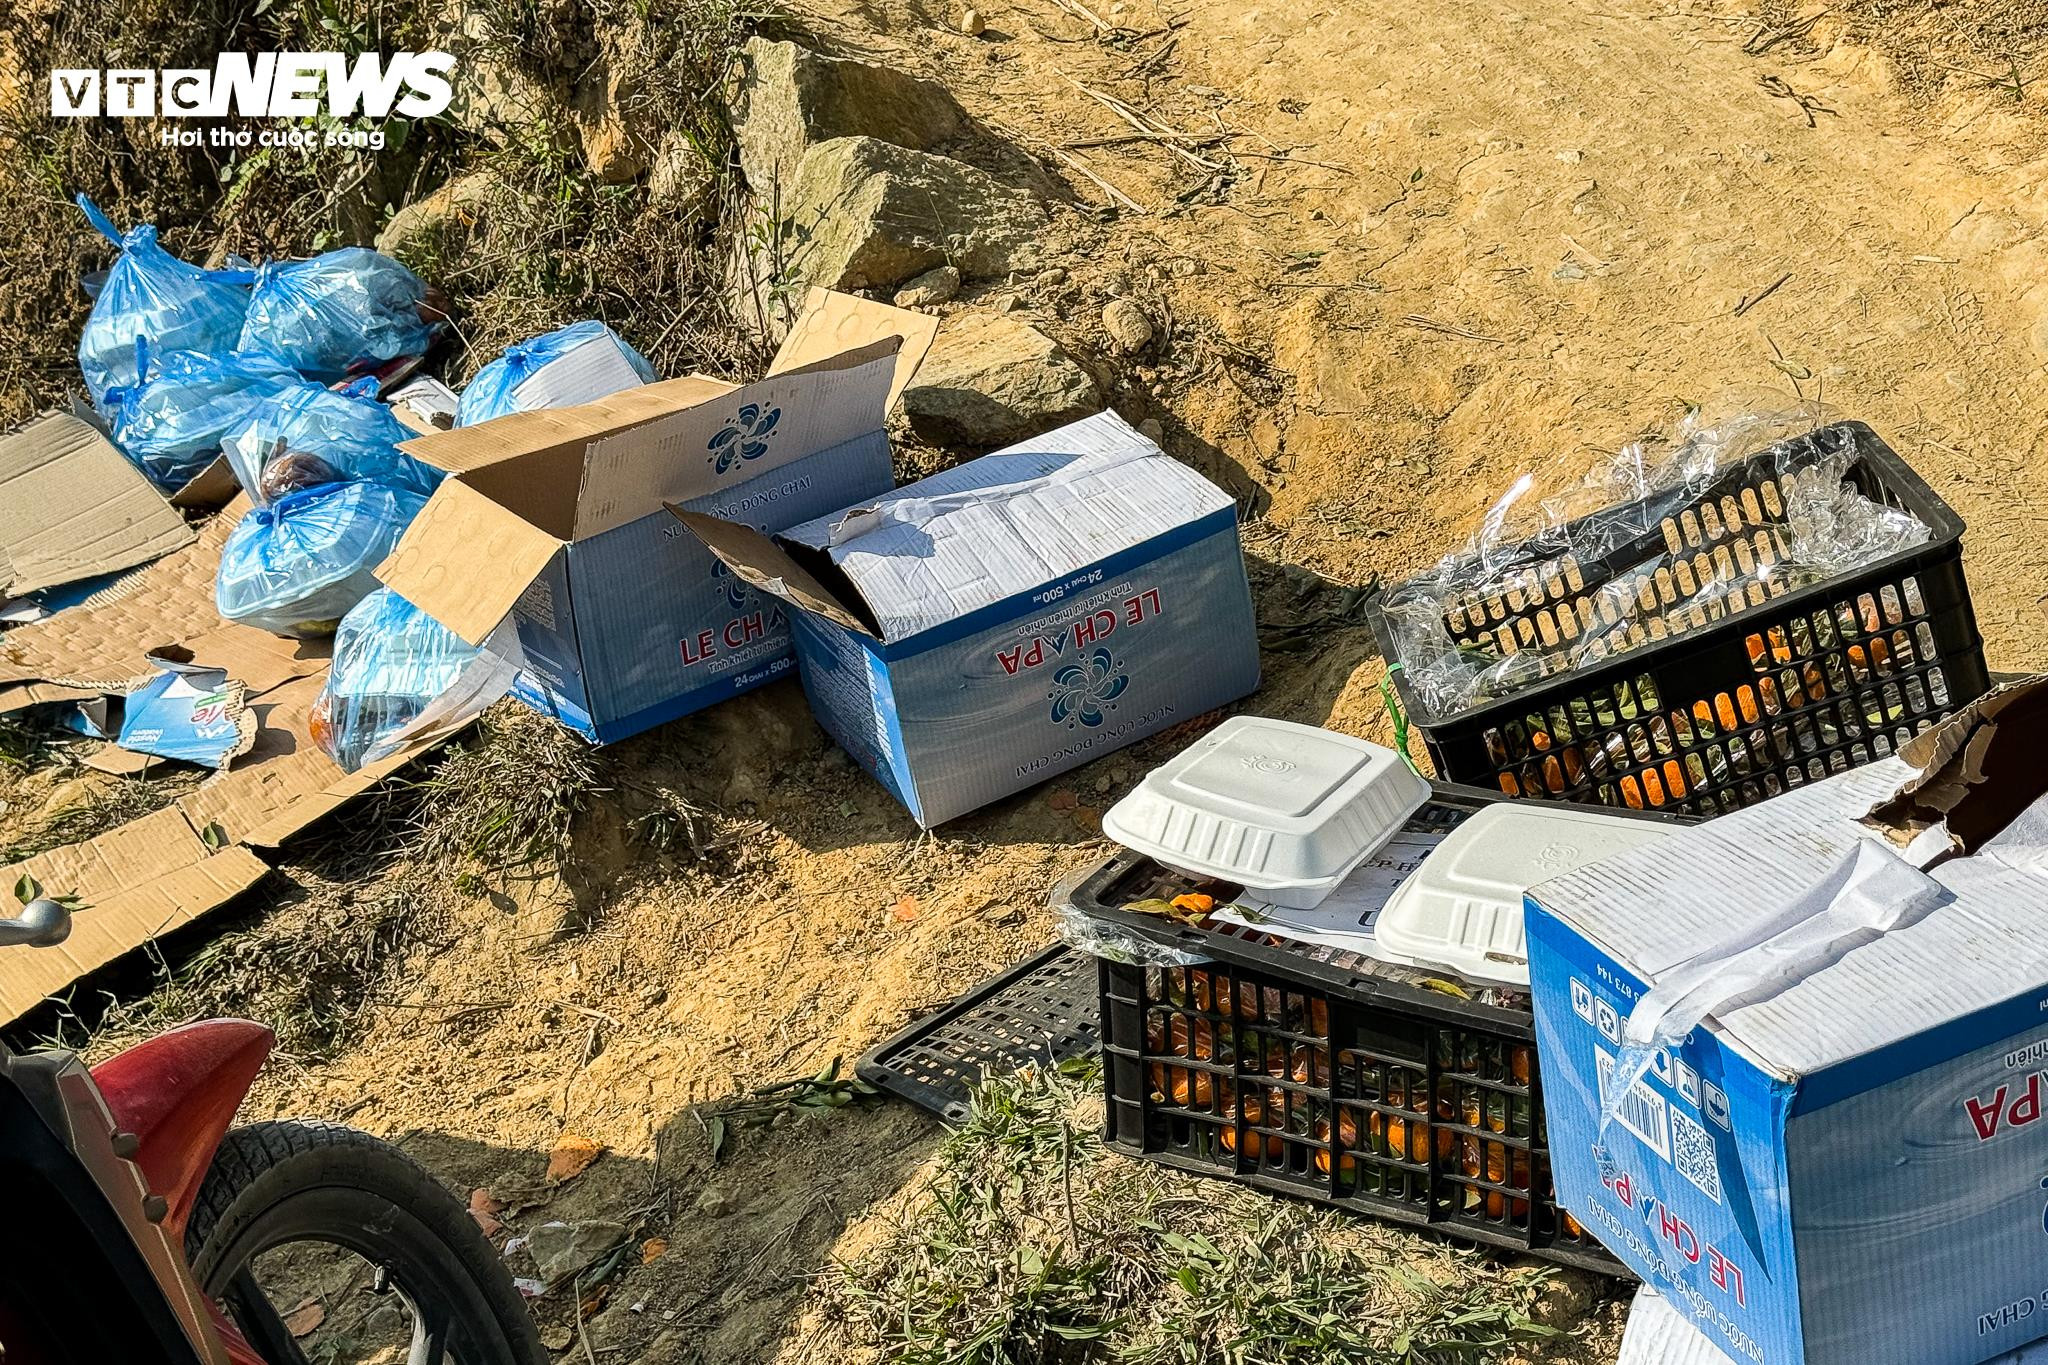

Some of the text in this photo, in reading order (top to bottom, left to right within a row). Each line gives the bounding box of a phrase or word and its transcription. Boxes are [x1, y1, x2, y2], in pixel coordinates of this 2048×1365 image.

[741, 487, 779, 512] ĐÓNG
[780, 474, 812, 497] CHAI
[1042, 585, 1064, 603] 500
[1071, 575, 1088, 588] CHAI
[1088, 569, 1103, 584] 24
[1123, 587, 1163, 628] LE
[680, 603, 789, 667] LE CHA
[734, 674, 749, 688] 24
[770, 658, 790, 673] 500
[1015, 756, 1050, 780] CHAI
[1597, 963, 1613, 984] 144
[1614, 975, 1632, 999] 873
[1588, 1194, 1624, 1239] CHAI
[1626, 1229, 1671, 1282] ĐÓNG
[1706, 1242, 1746, 1309] LE
[1977, 1297, 2037, 1337] CHAI
[1719, 1313, 1765, 1365] NƯỚC
